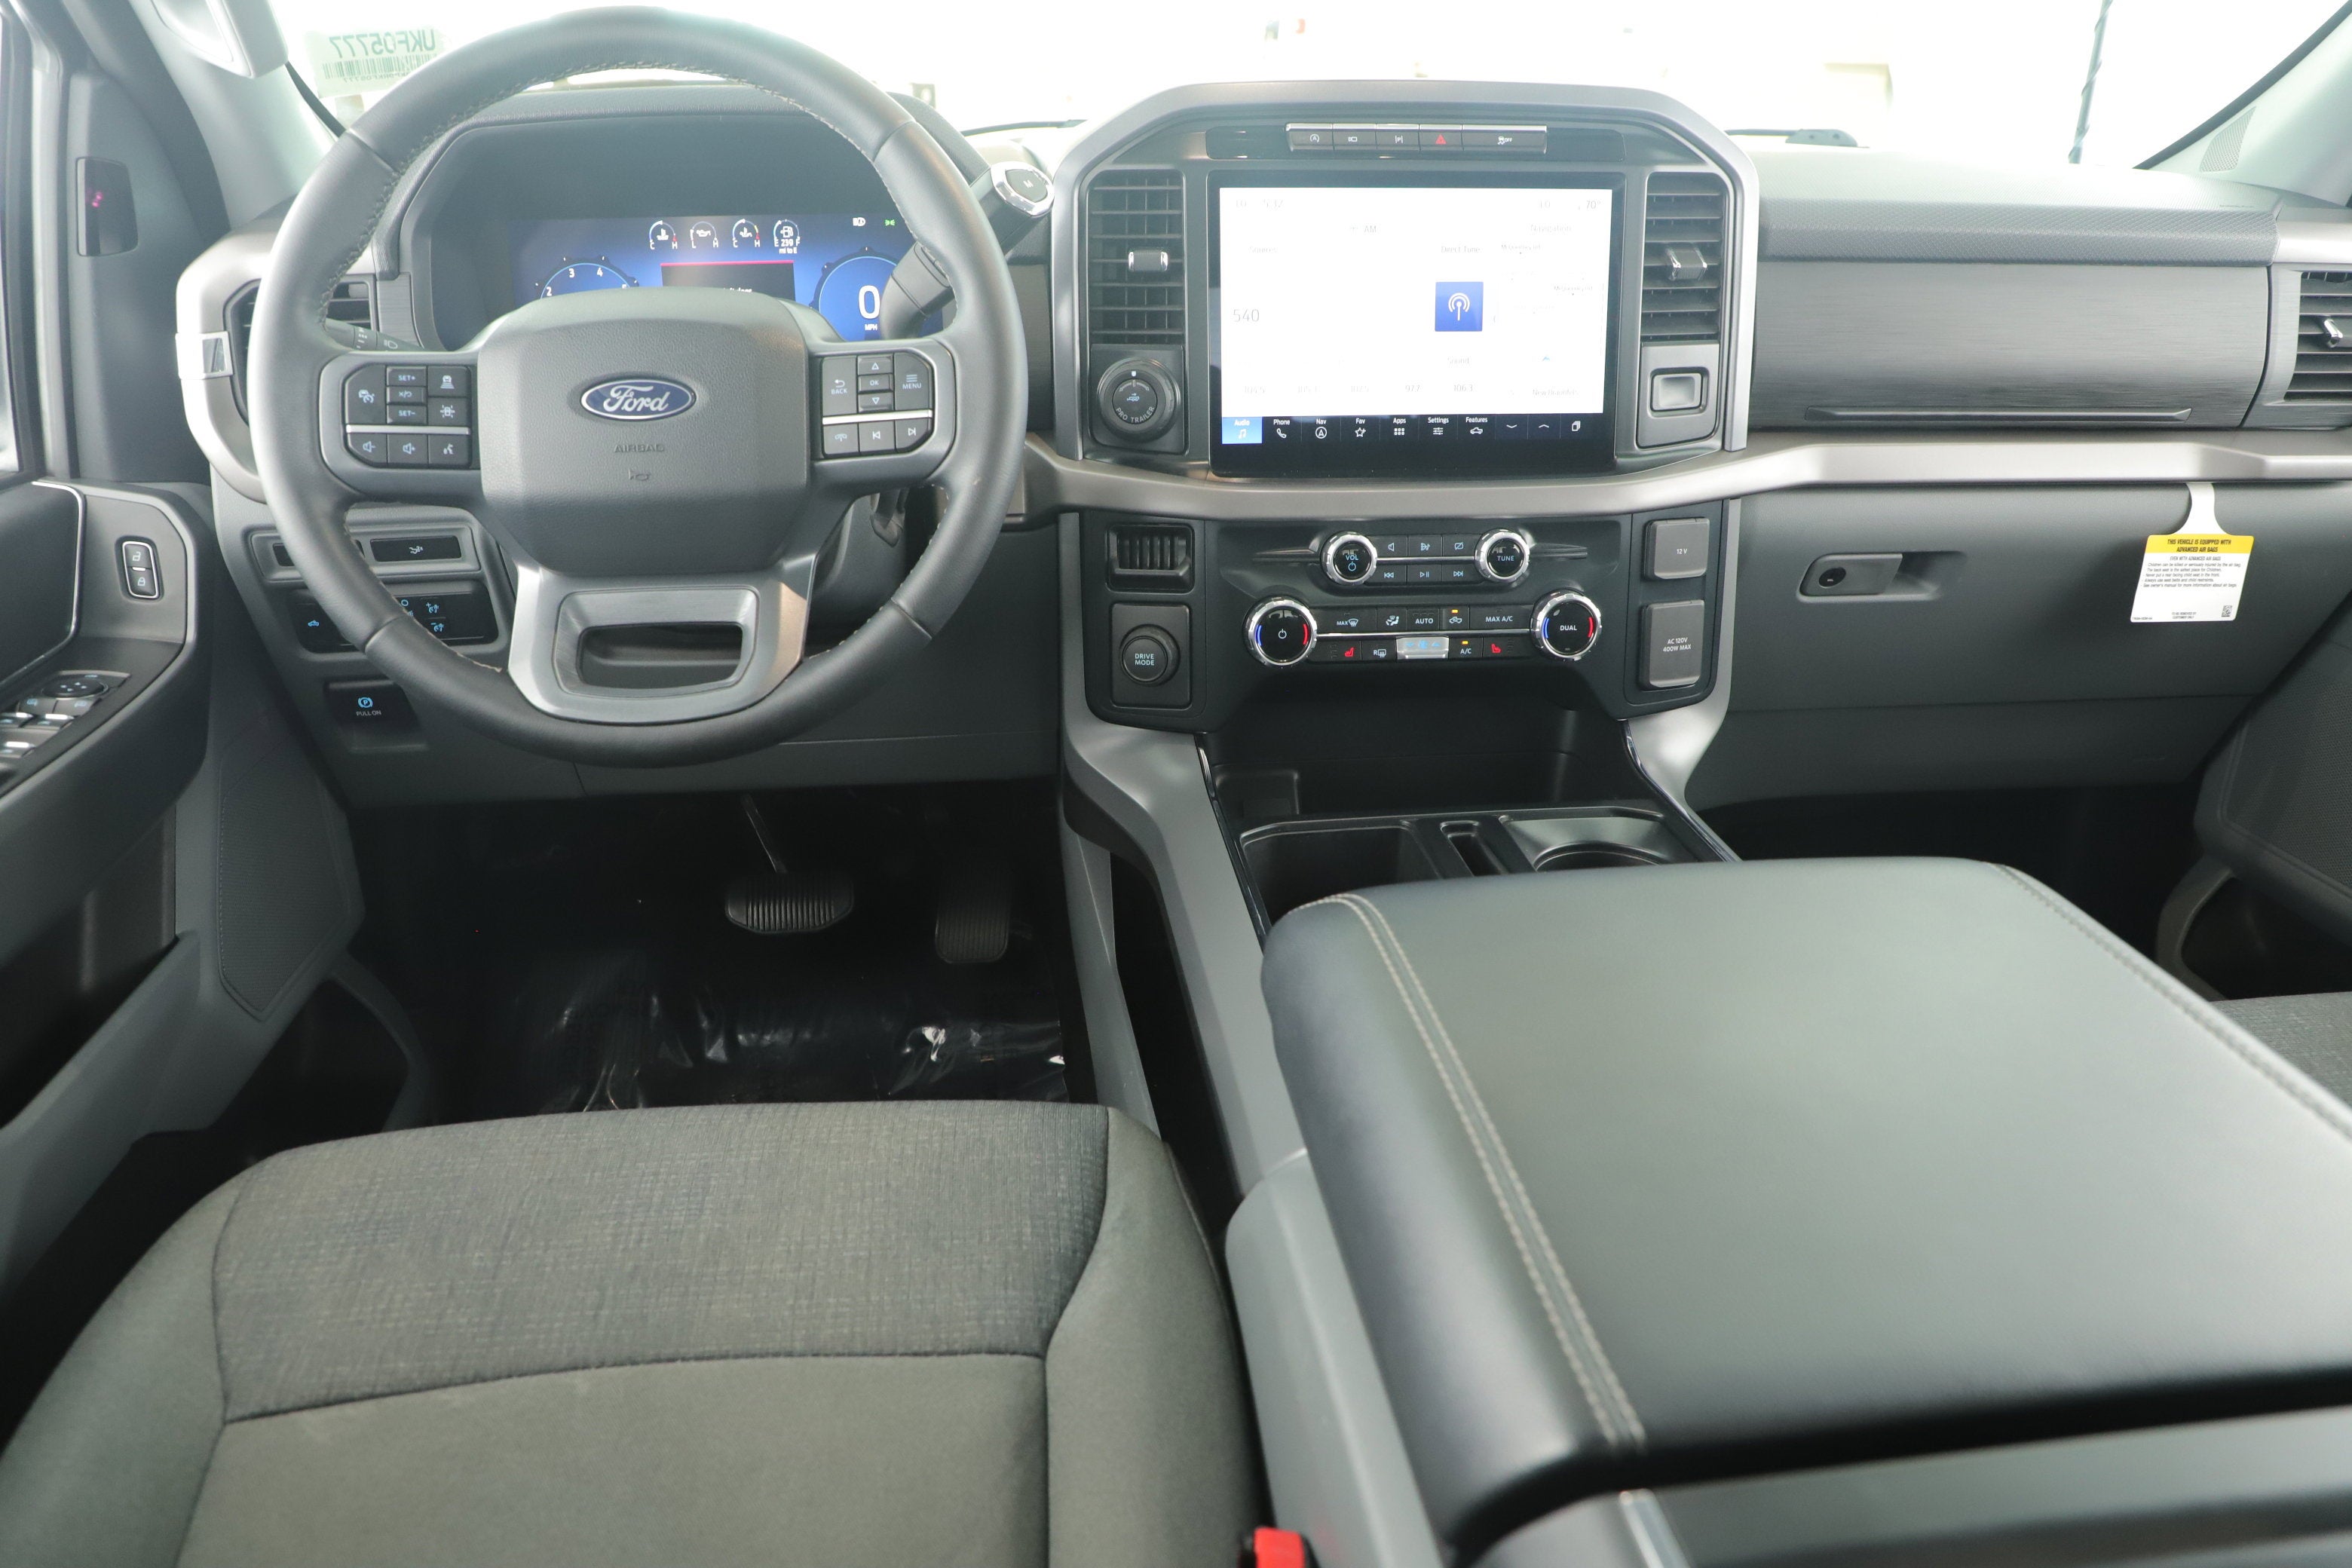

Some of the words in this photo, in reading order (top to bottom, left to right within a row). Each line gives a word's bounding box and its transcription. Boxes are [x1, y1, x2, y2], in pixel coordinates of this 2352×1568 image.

[1364, 225, 1377, 233] AM
[781, 238, 794, 247] 239
[568, 268, 575, 278] 3
[596, 267, 603, 277] 4
[546, 286, 552, 296] 2
[858, 285, 880, 319] 0
[1233, 308, 1260, 322] 540
[603, 384, 670, 412] Ford
[1116, 407, 1129, 421] PRO
[1131, 406, 1155, 423] TRAILER
